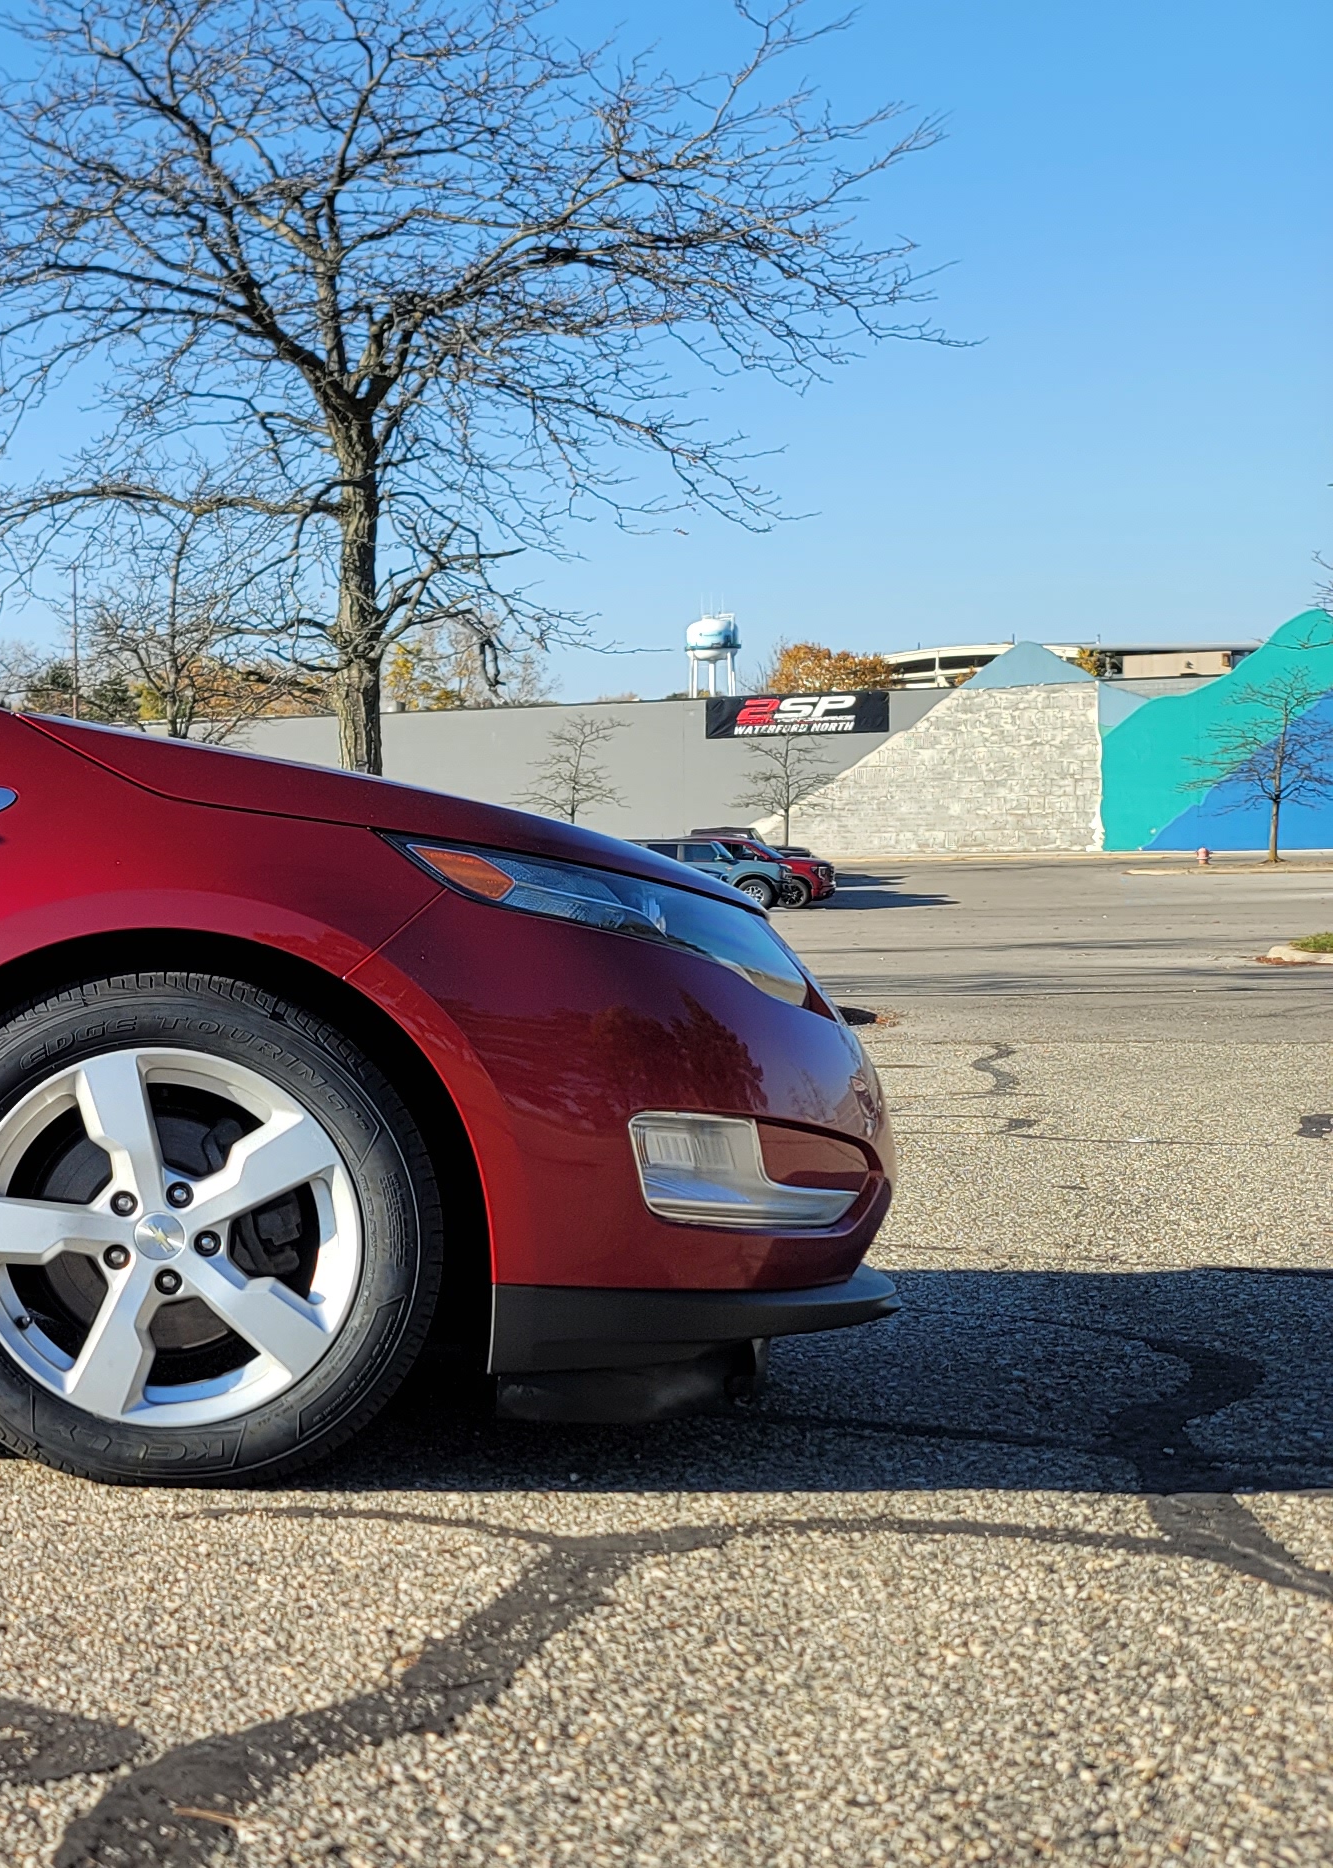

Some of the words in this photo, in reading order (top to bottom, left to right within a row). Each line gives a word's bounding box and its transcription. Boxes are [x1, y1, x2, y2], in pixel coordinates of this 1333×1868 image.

[733, 723, 807, 735] WATERFORD
[810, 721, 855, 732] NORTH
[19, 1015, 137, 1070] EDGE
[154, 1014, 350, 1112] TOURING
[56, 1424, 224, 1461] KELLY
